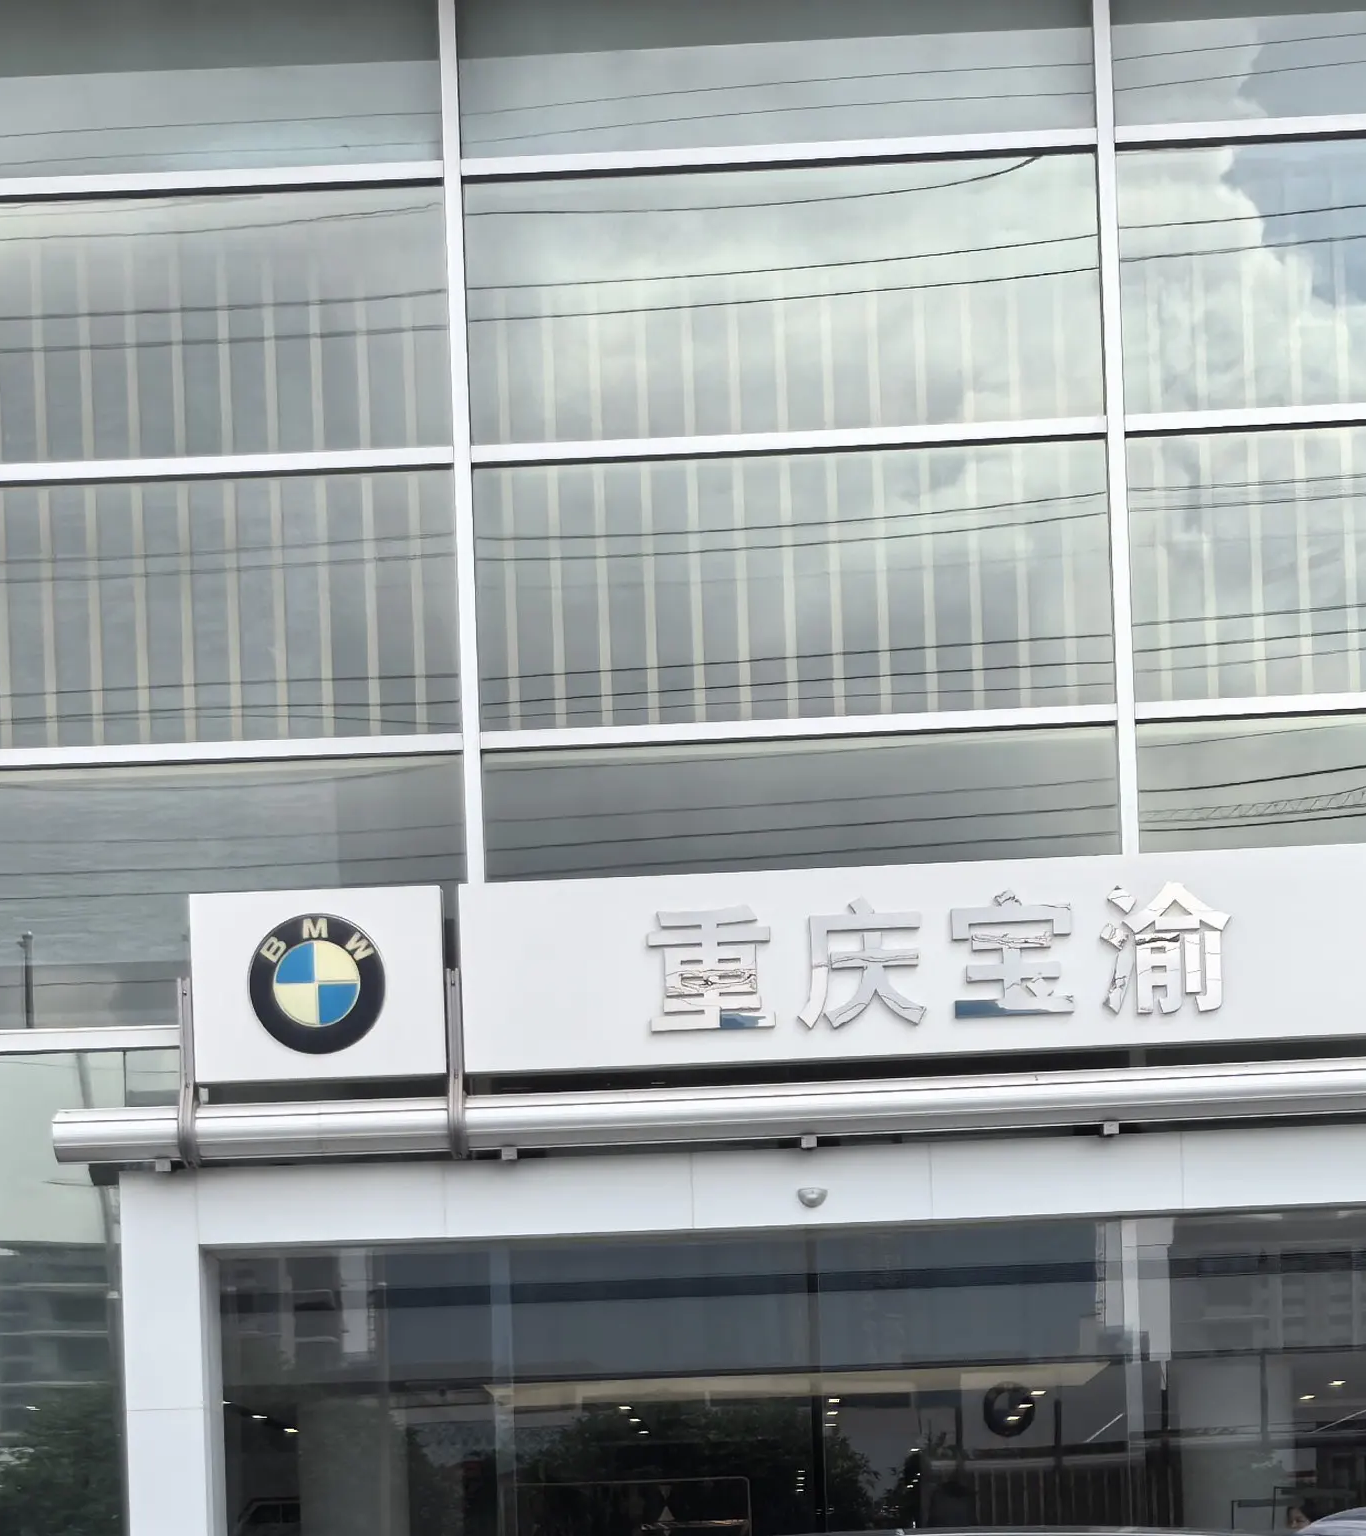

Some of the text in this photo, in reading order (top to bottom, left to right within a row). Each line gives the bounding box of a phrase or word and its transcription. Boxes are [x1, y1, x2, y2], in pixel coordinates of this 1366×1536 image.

[259, 917, 375, 964] BMW
[647, 881, 1232, 1034] 重庆宝渝
